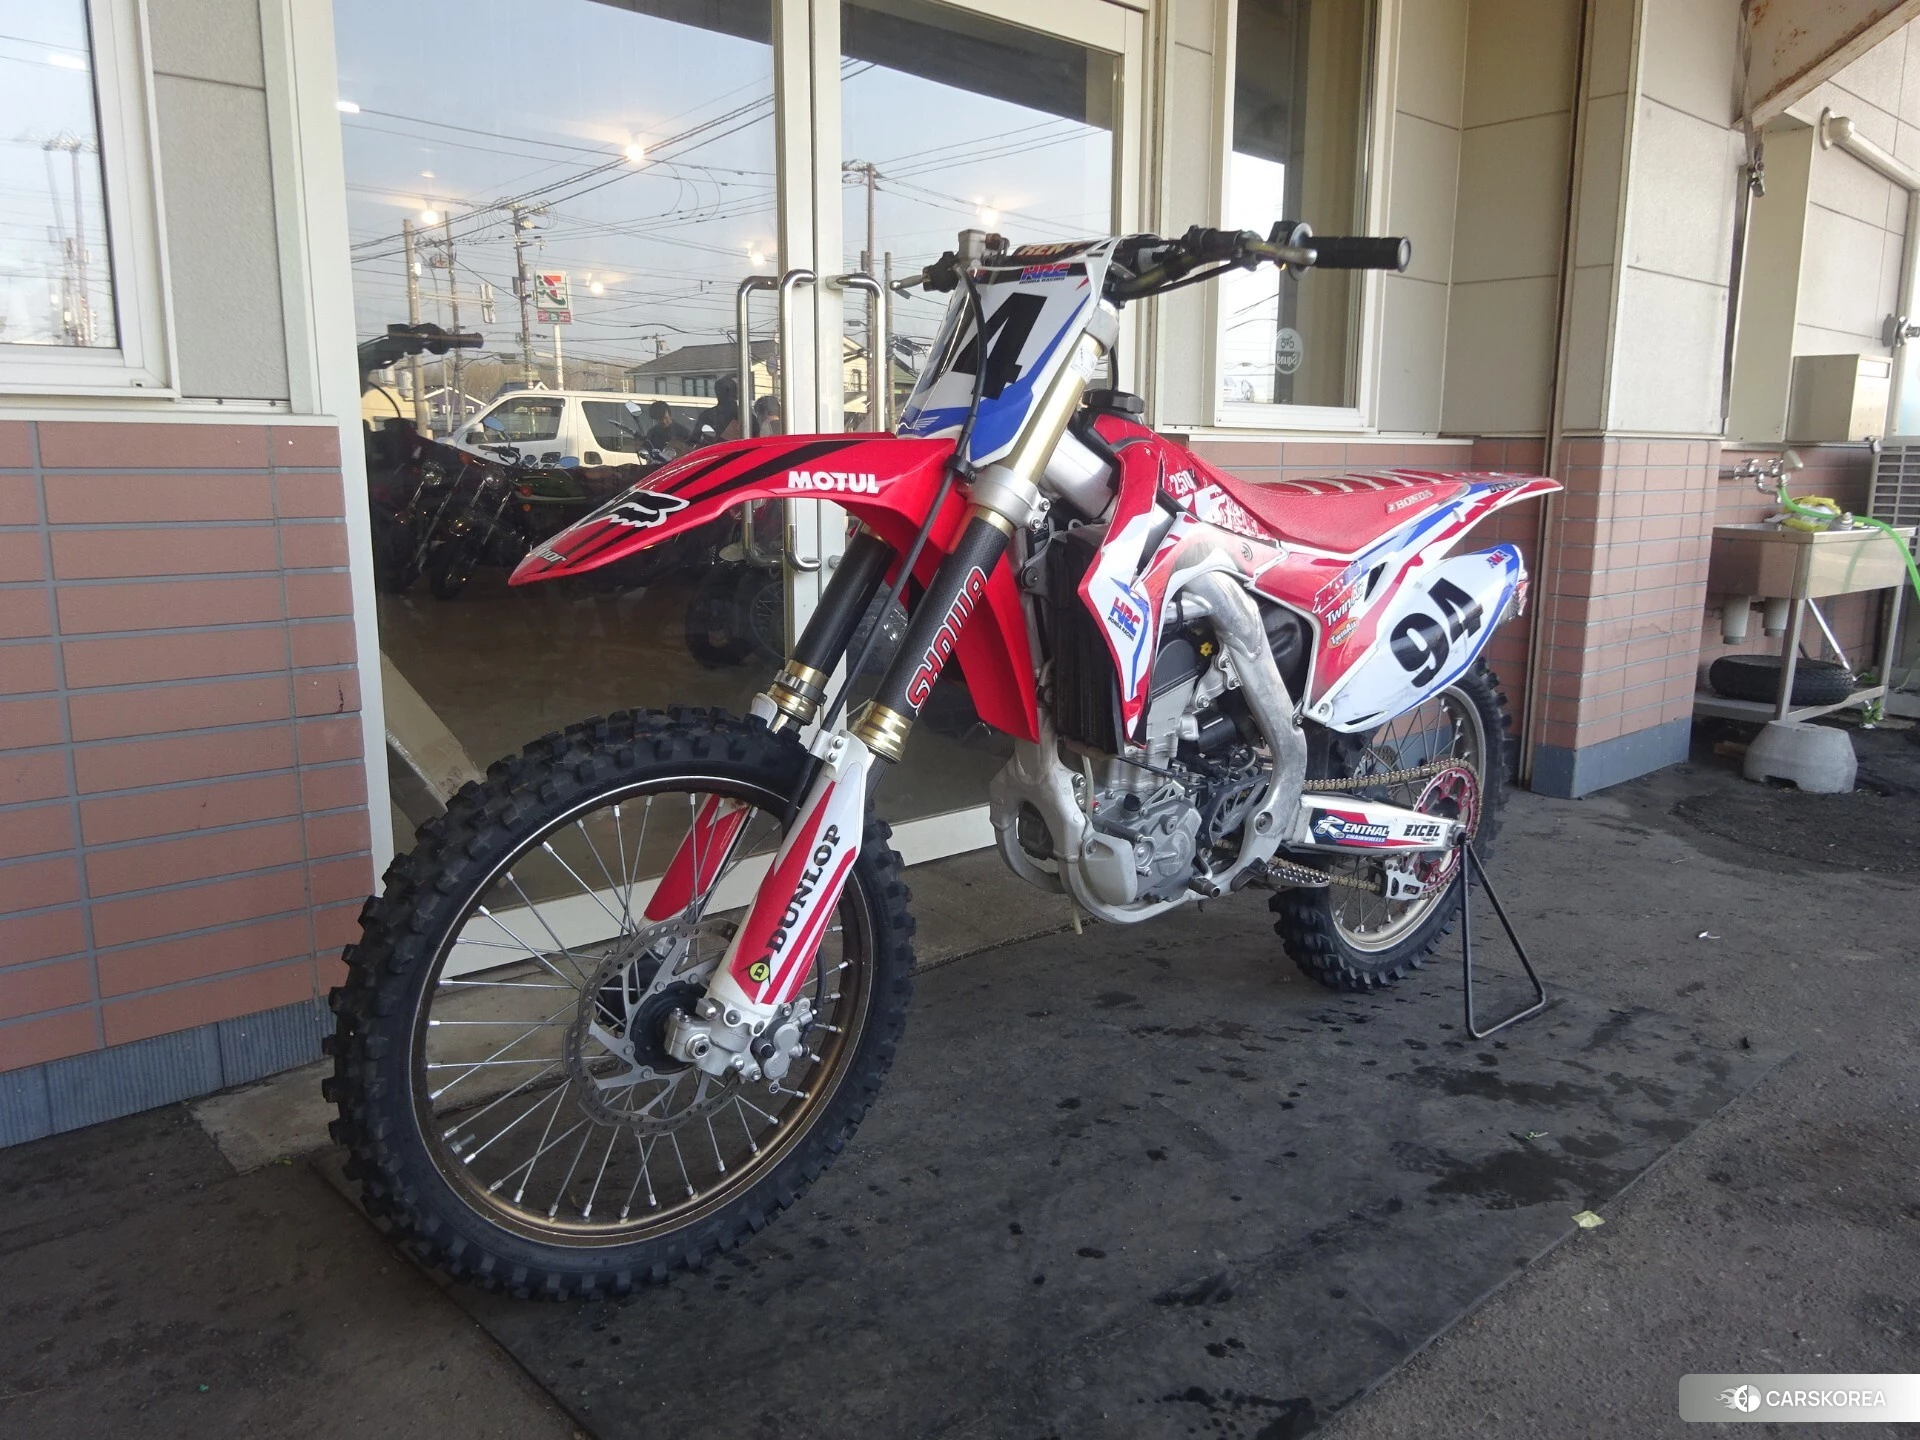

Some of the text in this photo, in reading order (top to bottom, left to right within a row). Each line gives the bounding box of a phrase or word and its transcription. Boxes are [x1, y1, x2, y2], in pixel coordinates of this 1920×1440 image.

[788, 470, 880, 494] MOTUL
[1397, 489, 1435, 510] HONDA
[1108, 616, 1135, 641] HONDA RACING
[1110, 597, 1141, 637] HRC
[1390, 577, 1484, 688] 94
[1345, 833, 1386, 843] CHAINWHEELS
[1403, 824, 1441, 837] EXCEL
[766, 823, 842, 955] DUNLOP
